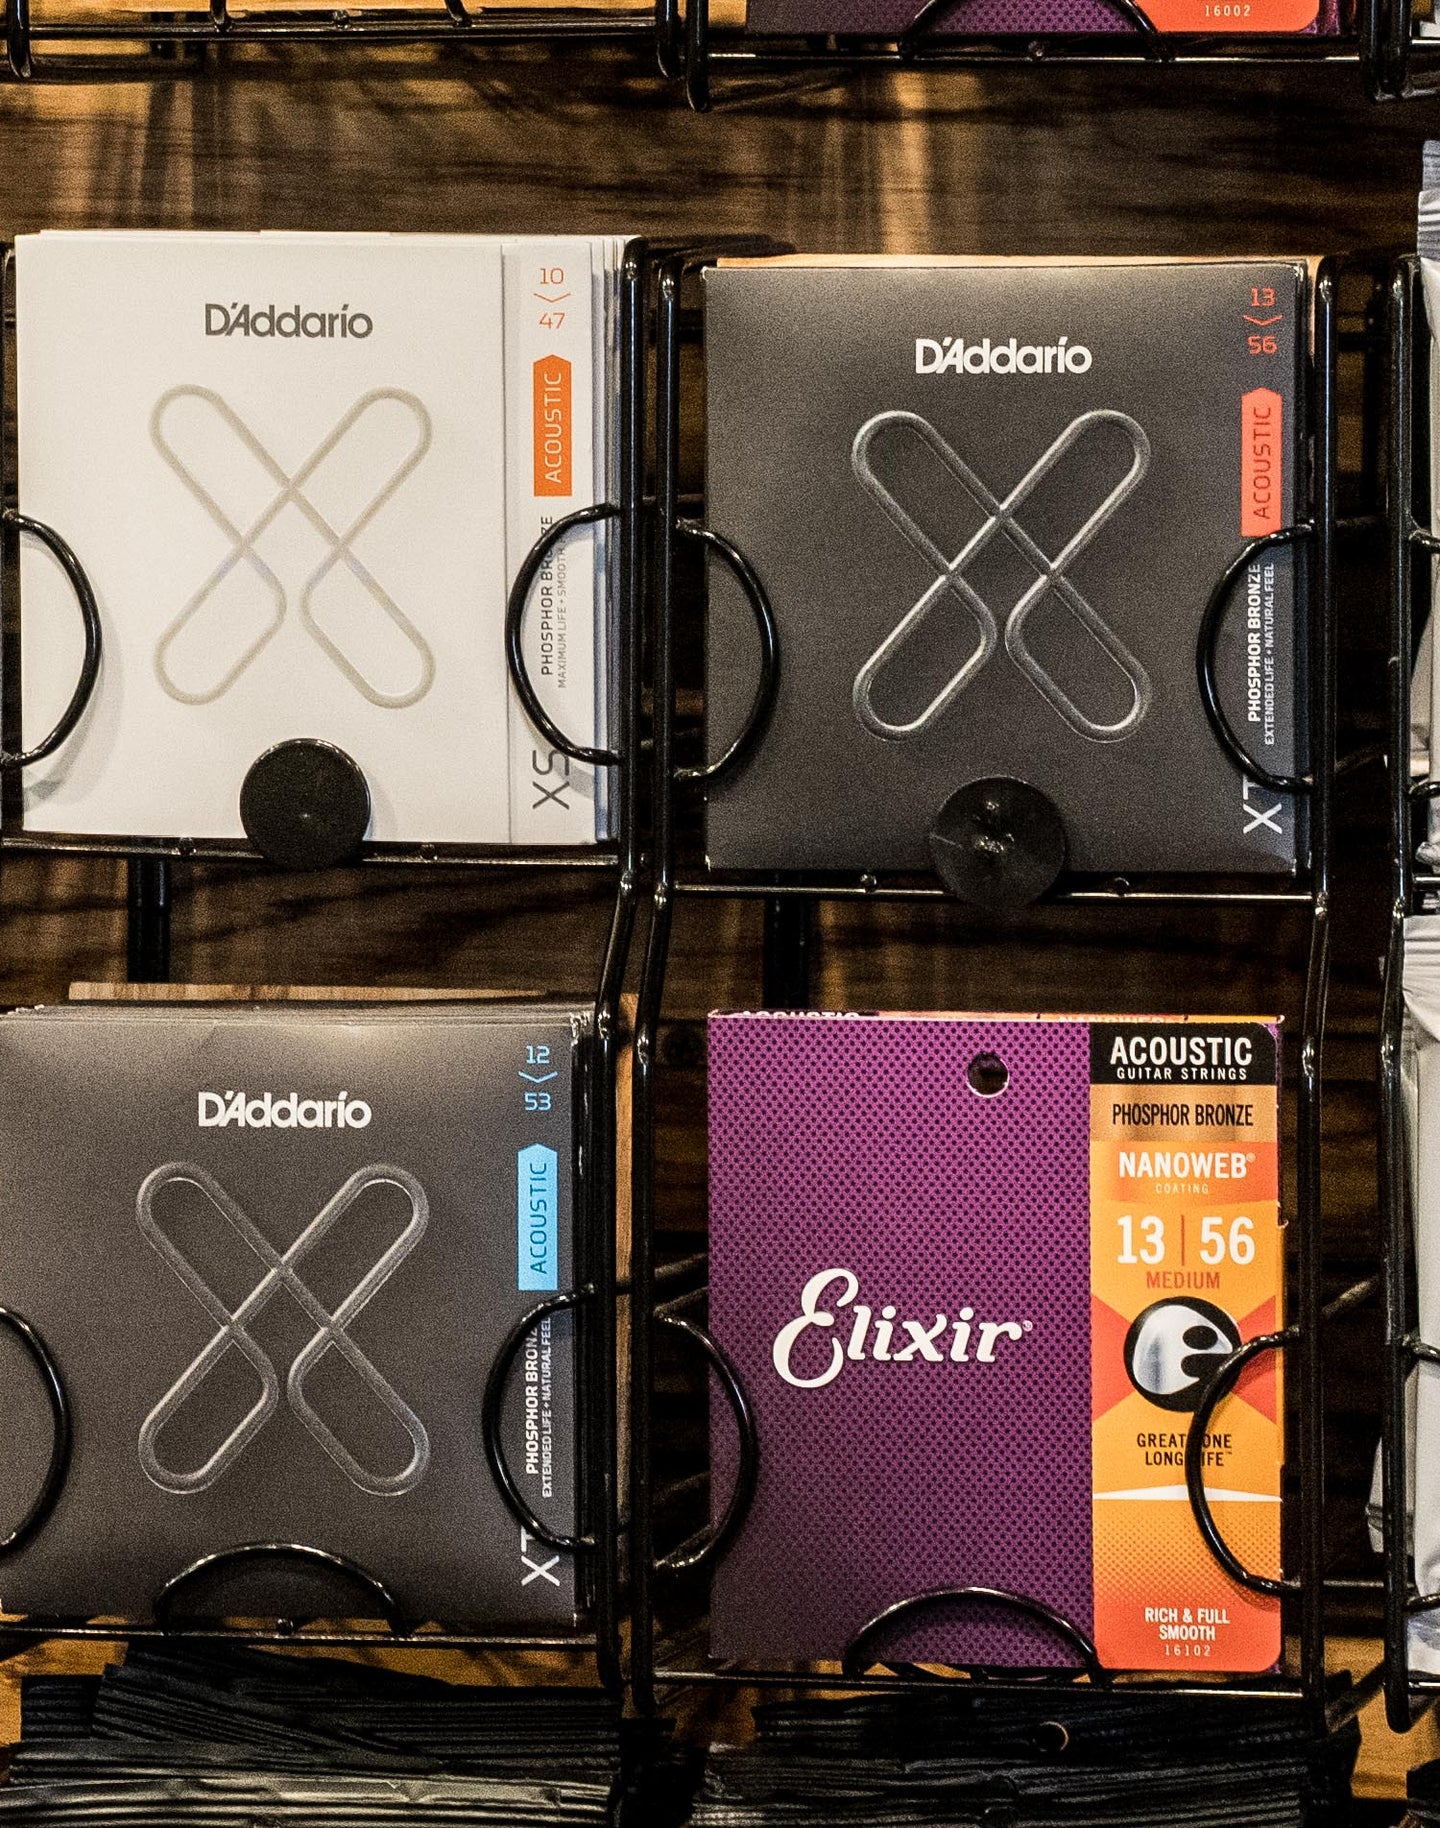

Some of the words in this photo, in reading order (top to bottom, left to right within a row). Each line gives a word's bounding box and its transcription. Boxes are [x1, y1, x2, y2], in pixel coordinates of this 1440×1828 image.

[1205, 5, 1251, 17] 16002
[539, 267, 565, 285] 10
[1250, 287, 1276, 307] 13
[205, 303, 373, 340] D'Addario
[538, 312, 566, 330] 47
[916, 336, 1092, 374] D'Addario
[1247, 335, 1278, 355] 56
[544, 372, 562, 484] ACOUSTIC
[1253, 407, 1271, 520] ACOUSTIC
[1247, 564, 1262, 629] BRONZE
[541, 591, 553, 676] PHOSPHOR
[1265, 595, 1274, 648] NATURAL
[1247, 633, 1262, 722] PHOSPHOR
[1264, 683, 1275, 745] EXTENDED
[525, 1045, 550, 1064] 12
[1110, 1036, 1253, 1066] ACOUSTIC
[1117, 1067, 1172, 1080] GUITAR
[1181, 1067, 1247, 1081] STRINGS
[197, 1091, 372, 1128] D'Addario
[524, 1092, 552, 1111] 53
[1112, 1103, 1190, 1126] PHOSPHOR
[1195, 1104, 1254, 1127] BRONZE
[1155, 1183, 1210, 1195] COATING
[530, 1162, 547, 1274] ACOUSTIC
[1117, 1215, 1165, 1265] 13
[1199, 1216, 1256, 1266] 56
[1146, 1271, 1221, 1289] MEDIUM
[541, 1347, 552, 1400] NATURAL
[525, 1385, 539, 1475] PHOSPHOR
[1137, 1433, 1187, 1448] GREAT
[541, 1435, 552, 1498] EXTENDED
[1145, 1451, 1183, 1466] LONG
[1145, 1607, 1178, 1623] RICH
[1182, 1608, 1193, 1623] &
[1197, 1608, 1230, 1624] FULL
[1159, 1625, 1216, 1641] SMOOTH
[1165, 1645, 1211, 1657] 16102
